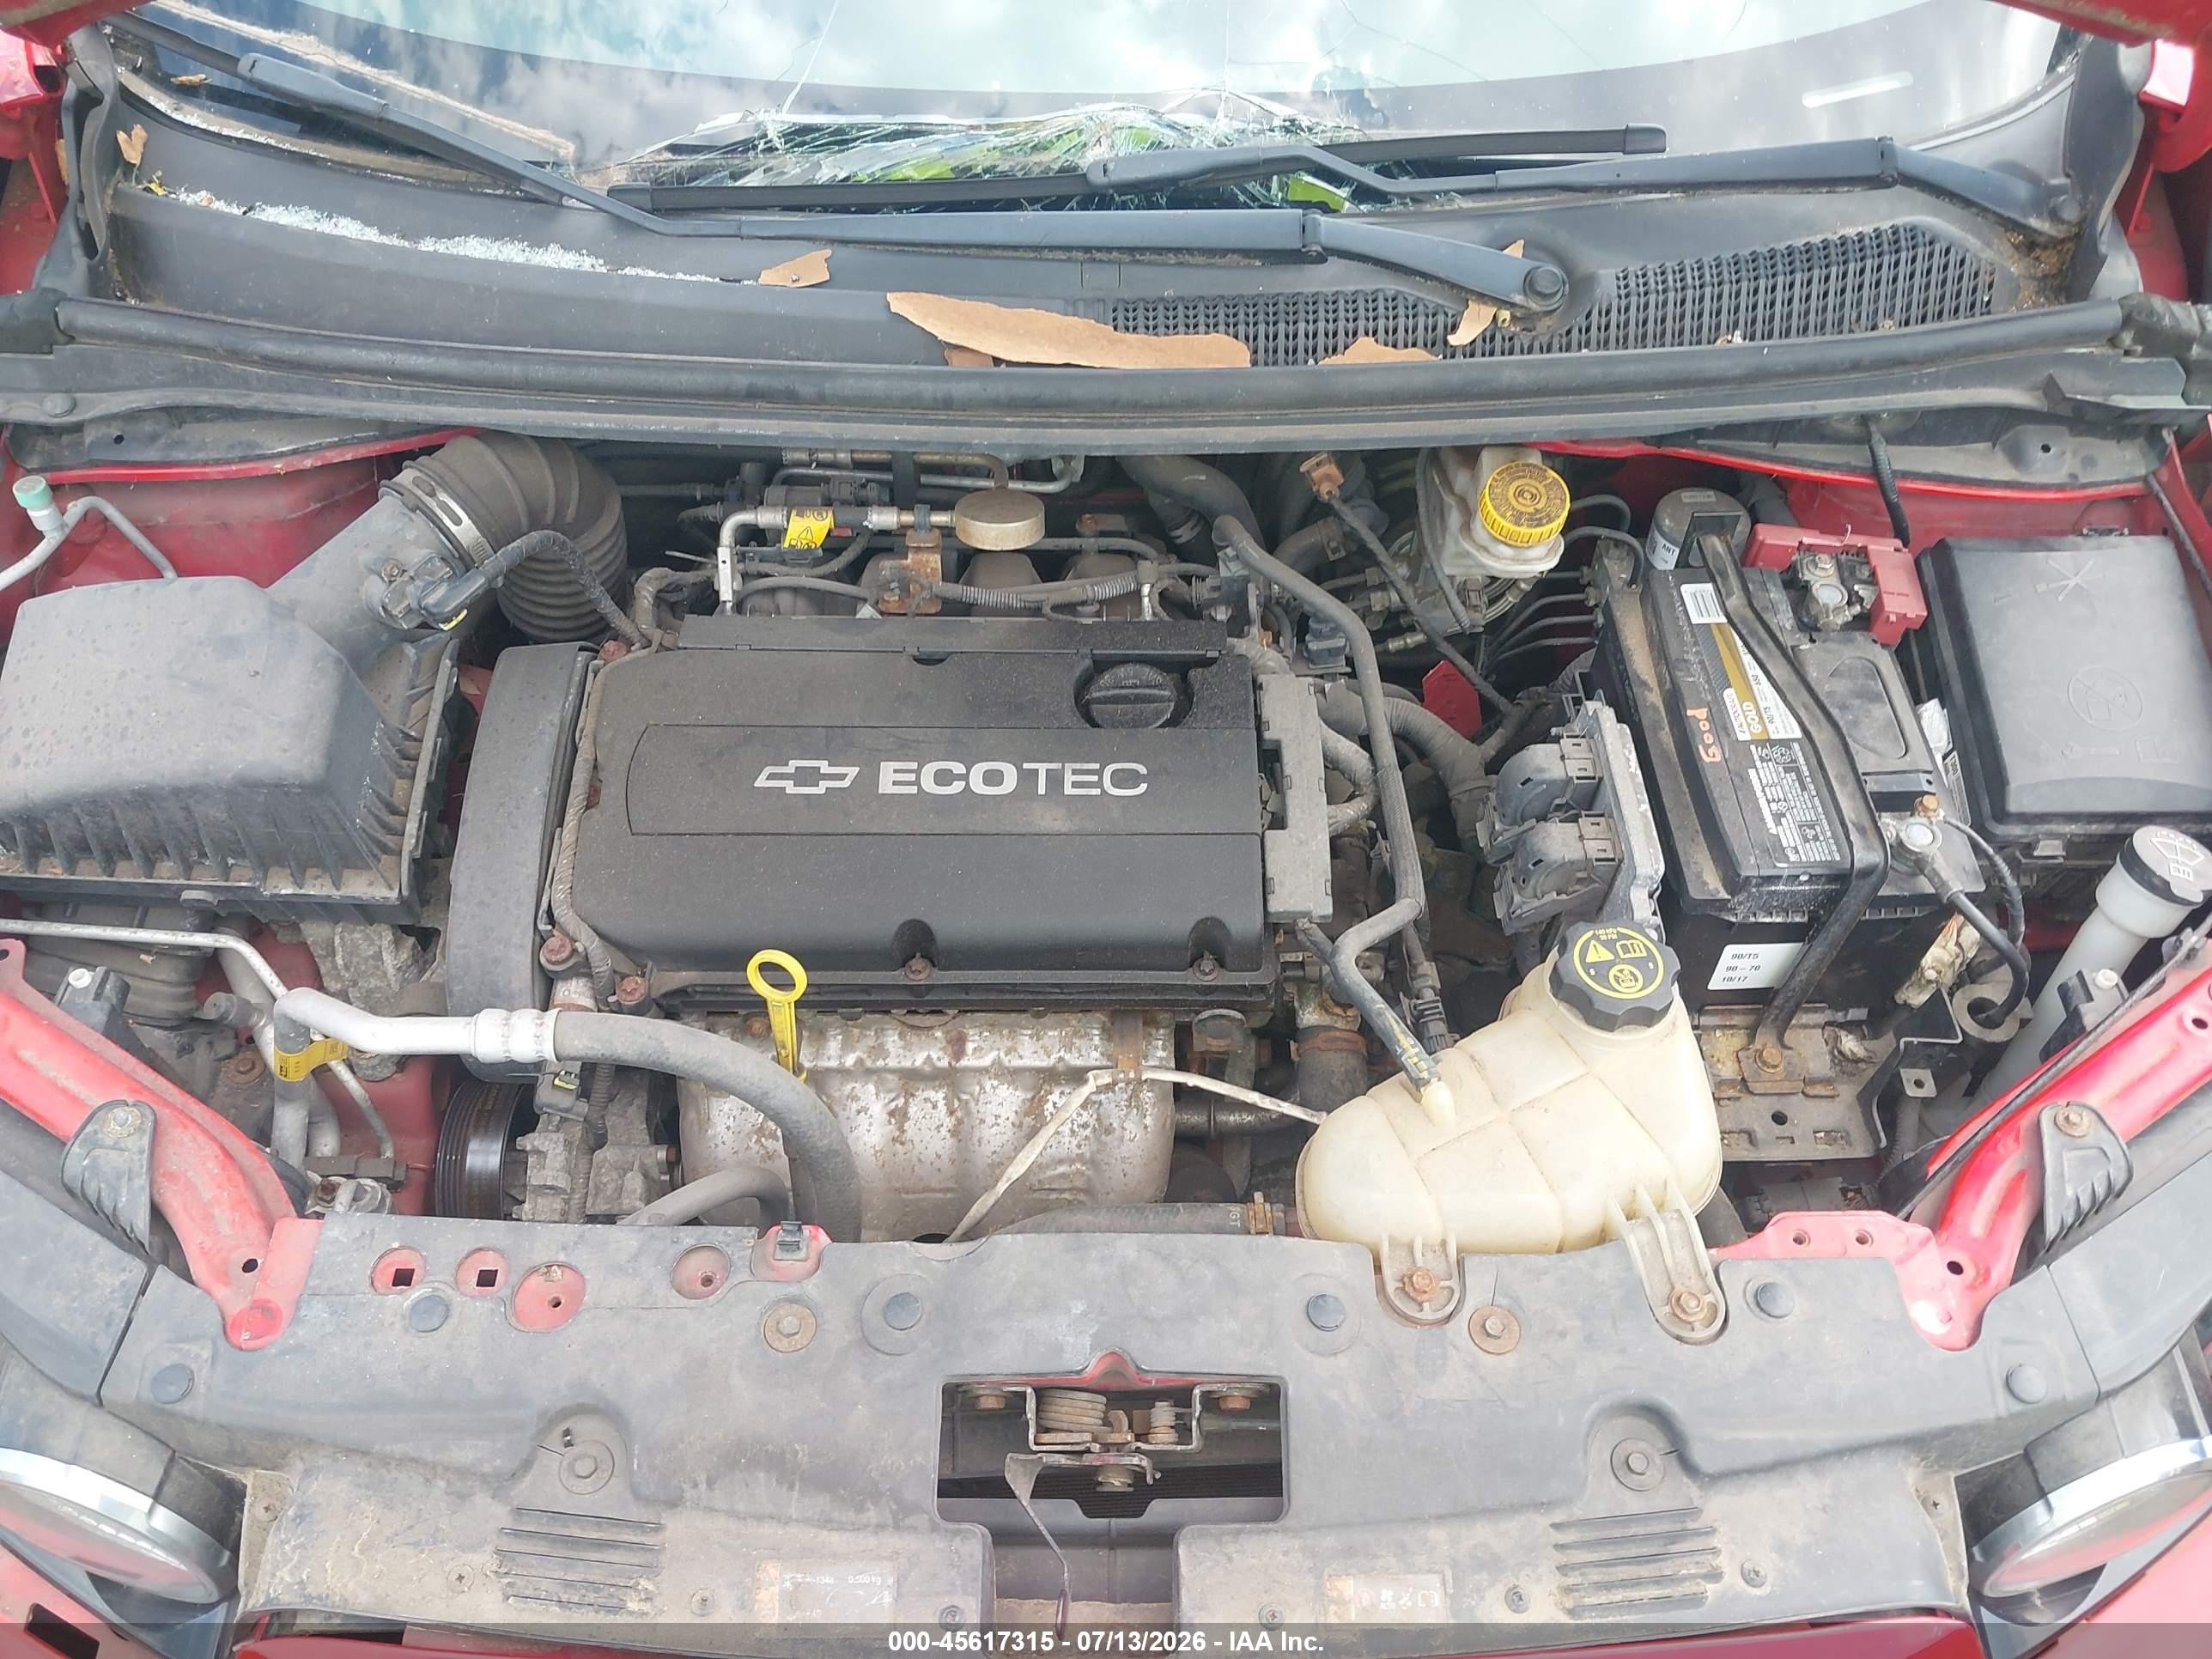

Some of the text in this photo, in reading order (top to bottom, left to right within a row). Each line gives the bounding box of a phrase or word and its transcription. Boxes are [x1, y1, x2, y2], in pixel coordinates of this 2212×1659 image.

[1742, 701, 1762, 734] GOLD
[1686, 708, 1722, 763] Good
[878, 761, 1148, 796] ECOTEC
